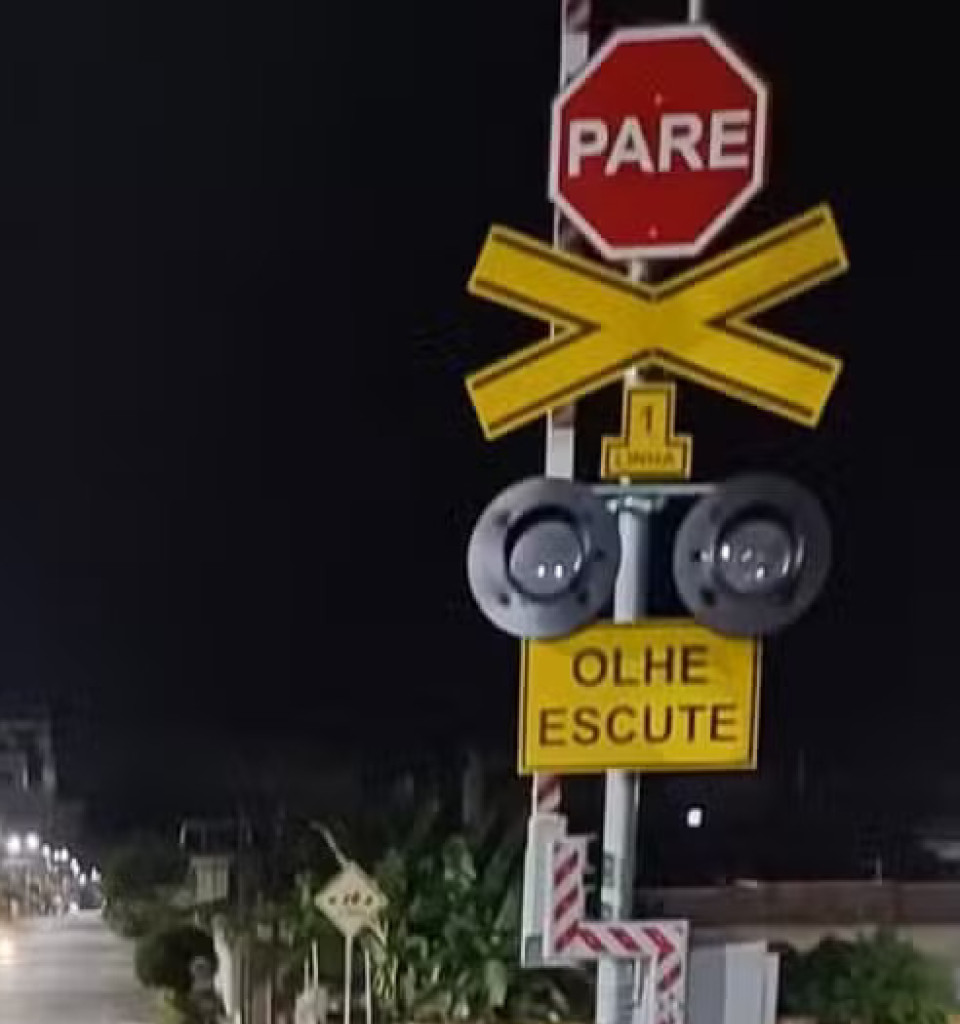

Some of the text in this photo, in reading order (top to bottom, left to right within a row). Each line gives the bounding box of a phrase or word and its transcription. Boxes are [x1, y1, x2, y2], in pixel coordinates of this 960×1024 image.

[568, 109, 751, 179] PARE
[642, 404, 653, 435] 1
[572, 644, 710, 687] OLHE
[539, 703, 739, 747] ESCUTE
